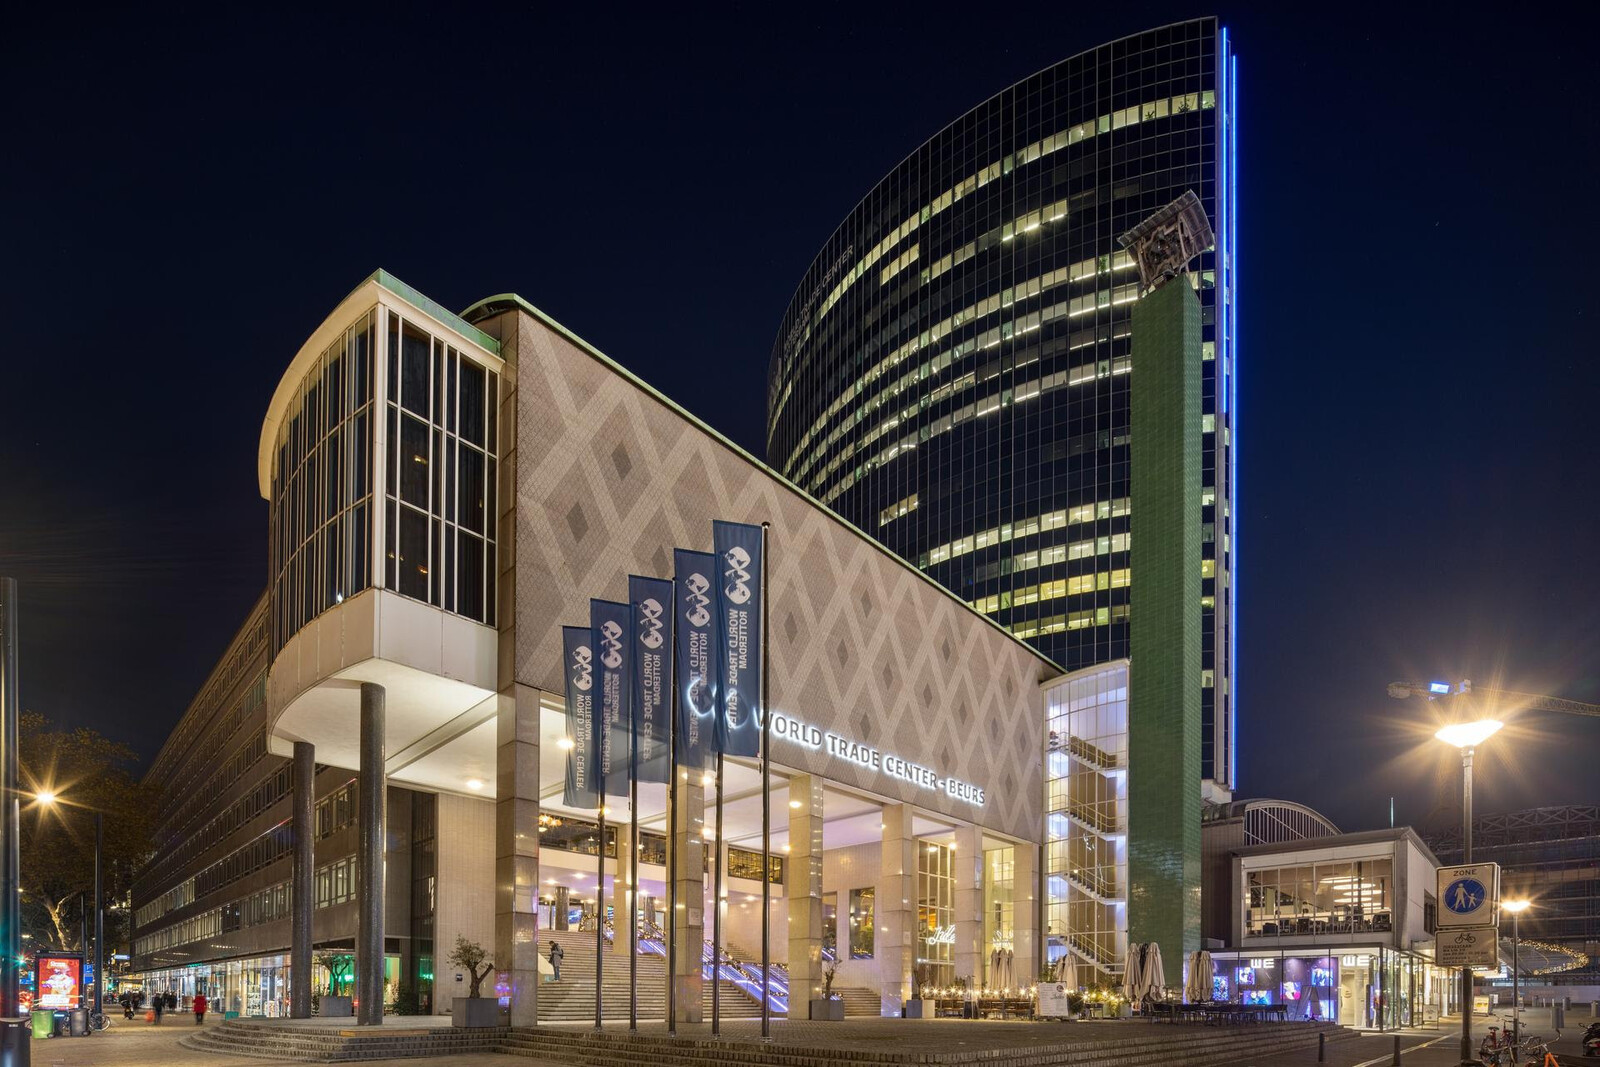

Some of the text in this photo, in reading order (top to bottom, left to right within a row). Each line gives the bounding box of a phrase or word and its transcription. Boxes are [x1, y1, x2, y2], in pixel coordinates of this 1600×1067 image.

[822, 245, 853, 288] CENTER
[828, 734, 880, 768] TRADE
[885, 757, 937, 789] CENTER
[949, 779, 985, 804] BEURS
[1453, 868, 1477, 877] ZONE
[1250, 958, 1275, 969] WE
[1342, 955, 1370, 967] WE
